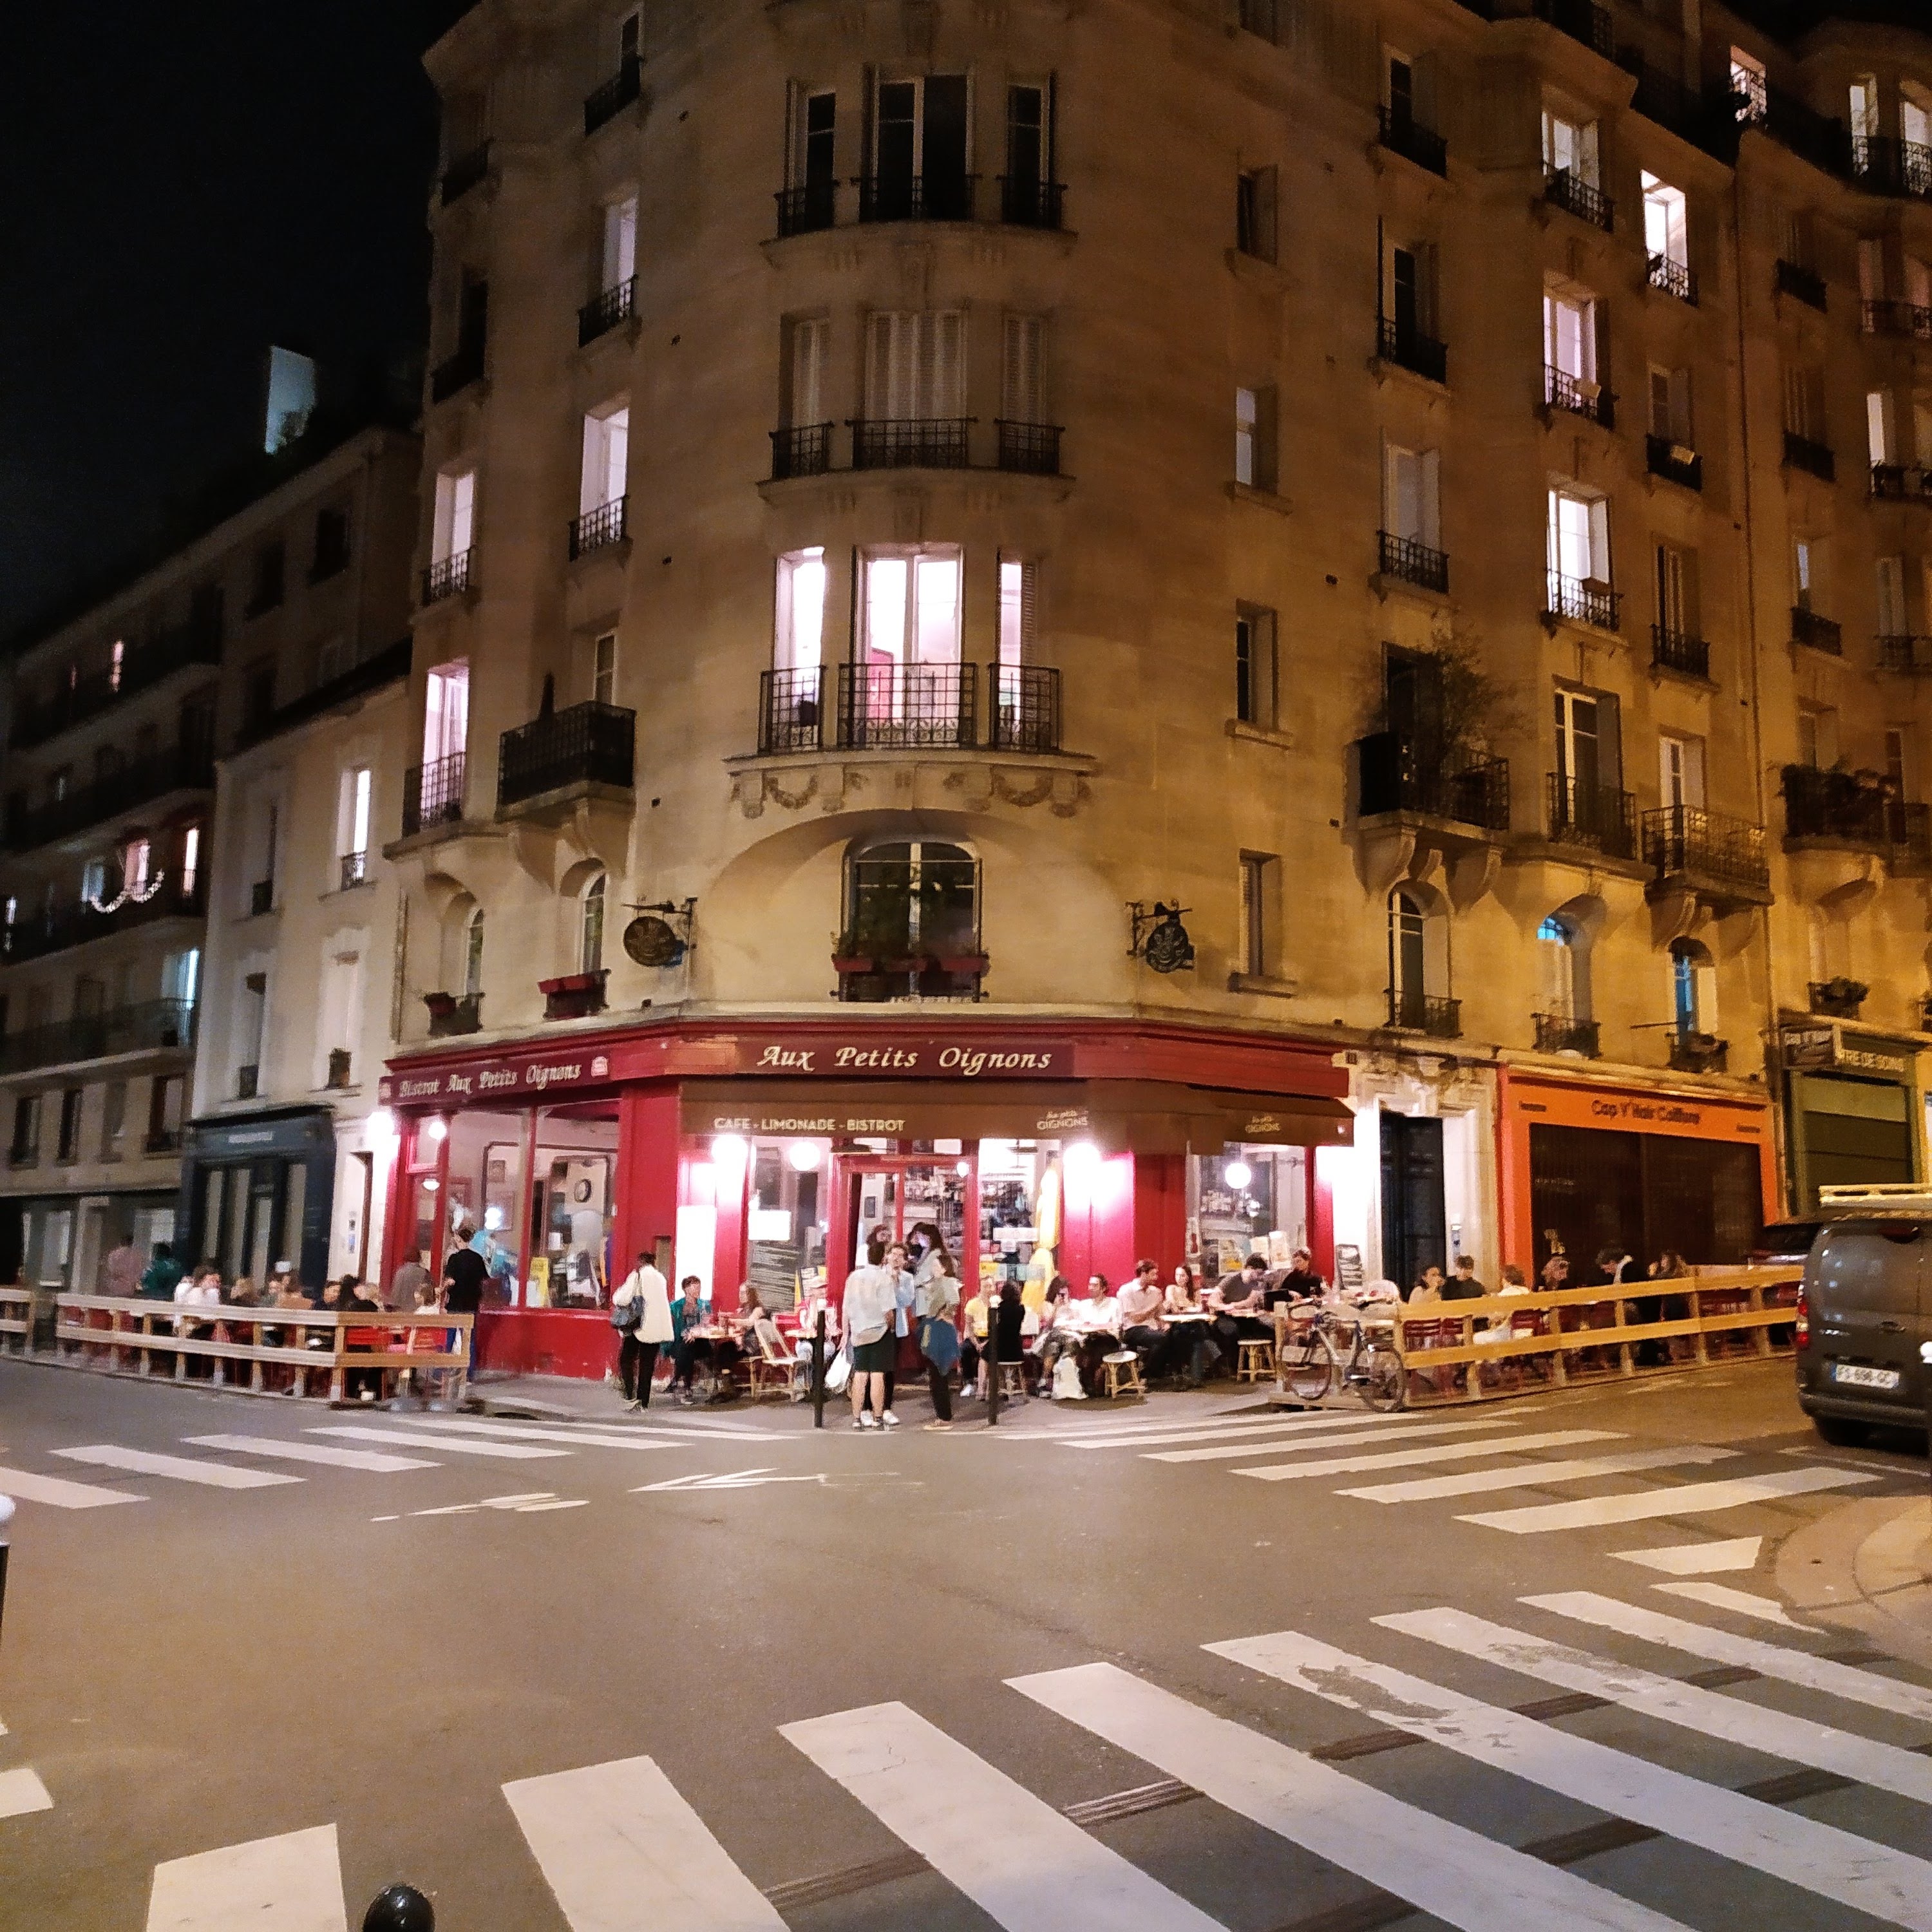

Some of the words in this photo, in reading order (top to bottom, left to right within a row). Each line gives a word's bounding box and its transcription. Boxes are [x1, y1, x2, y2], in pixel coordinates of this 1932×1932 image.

[757, 1045, 816, 1072] Aux
[833, 1046, 919, 1068] Petits
[938, 1046, 1052, 1075] Oignons
[446, 1074, 473, 1094] Aux
[478, 1069, 518, 1089] Petits
[526, 1064, 582, 1090] Oignons
[1591, 1099, 1617, 1119] Cap
[761, 1118, 836, 1131] LIMONADE
[847, 1119, 905, 1132] BISTROT
